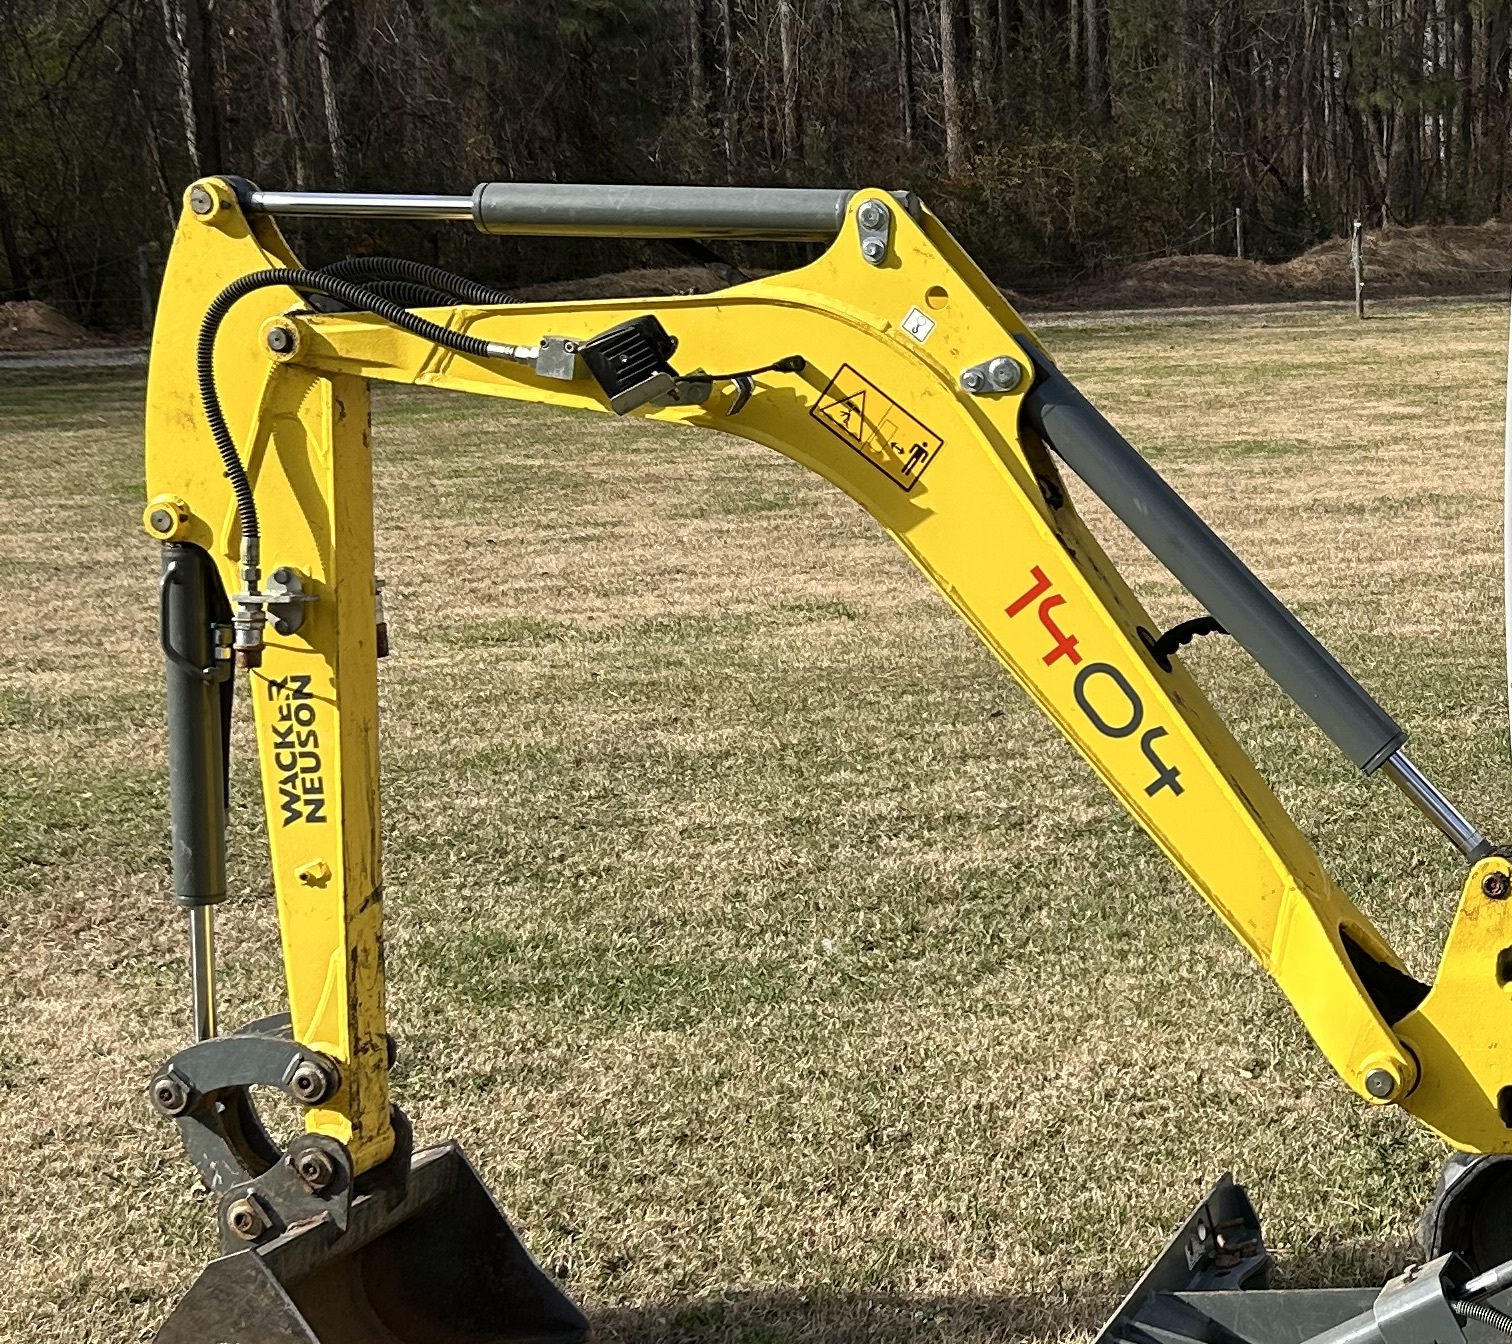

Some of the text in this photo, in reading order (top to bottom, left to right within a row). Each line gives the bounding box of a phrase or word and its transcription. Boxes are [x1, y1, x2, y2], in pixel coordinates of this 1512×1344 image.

[267, 675, 304, 828] WACKER
[289, 674, 328, 823] NEUSON
[1004, 564, 1186, 798] 1404
